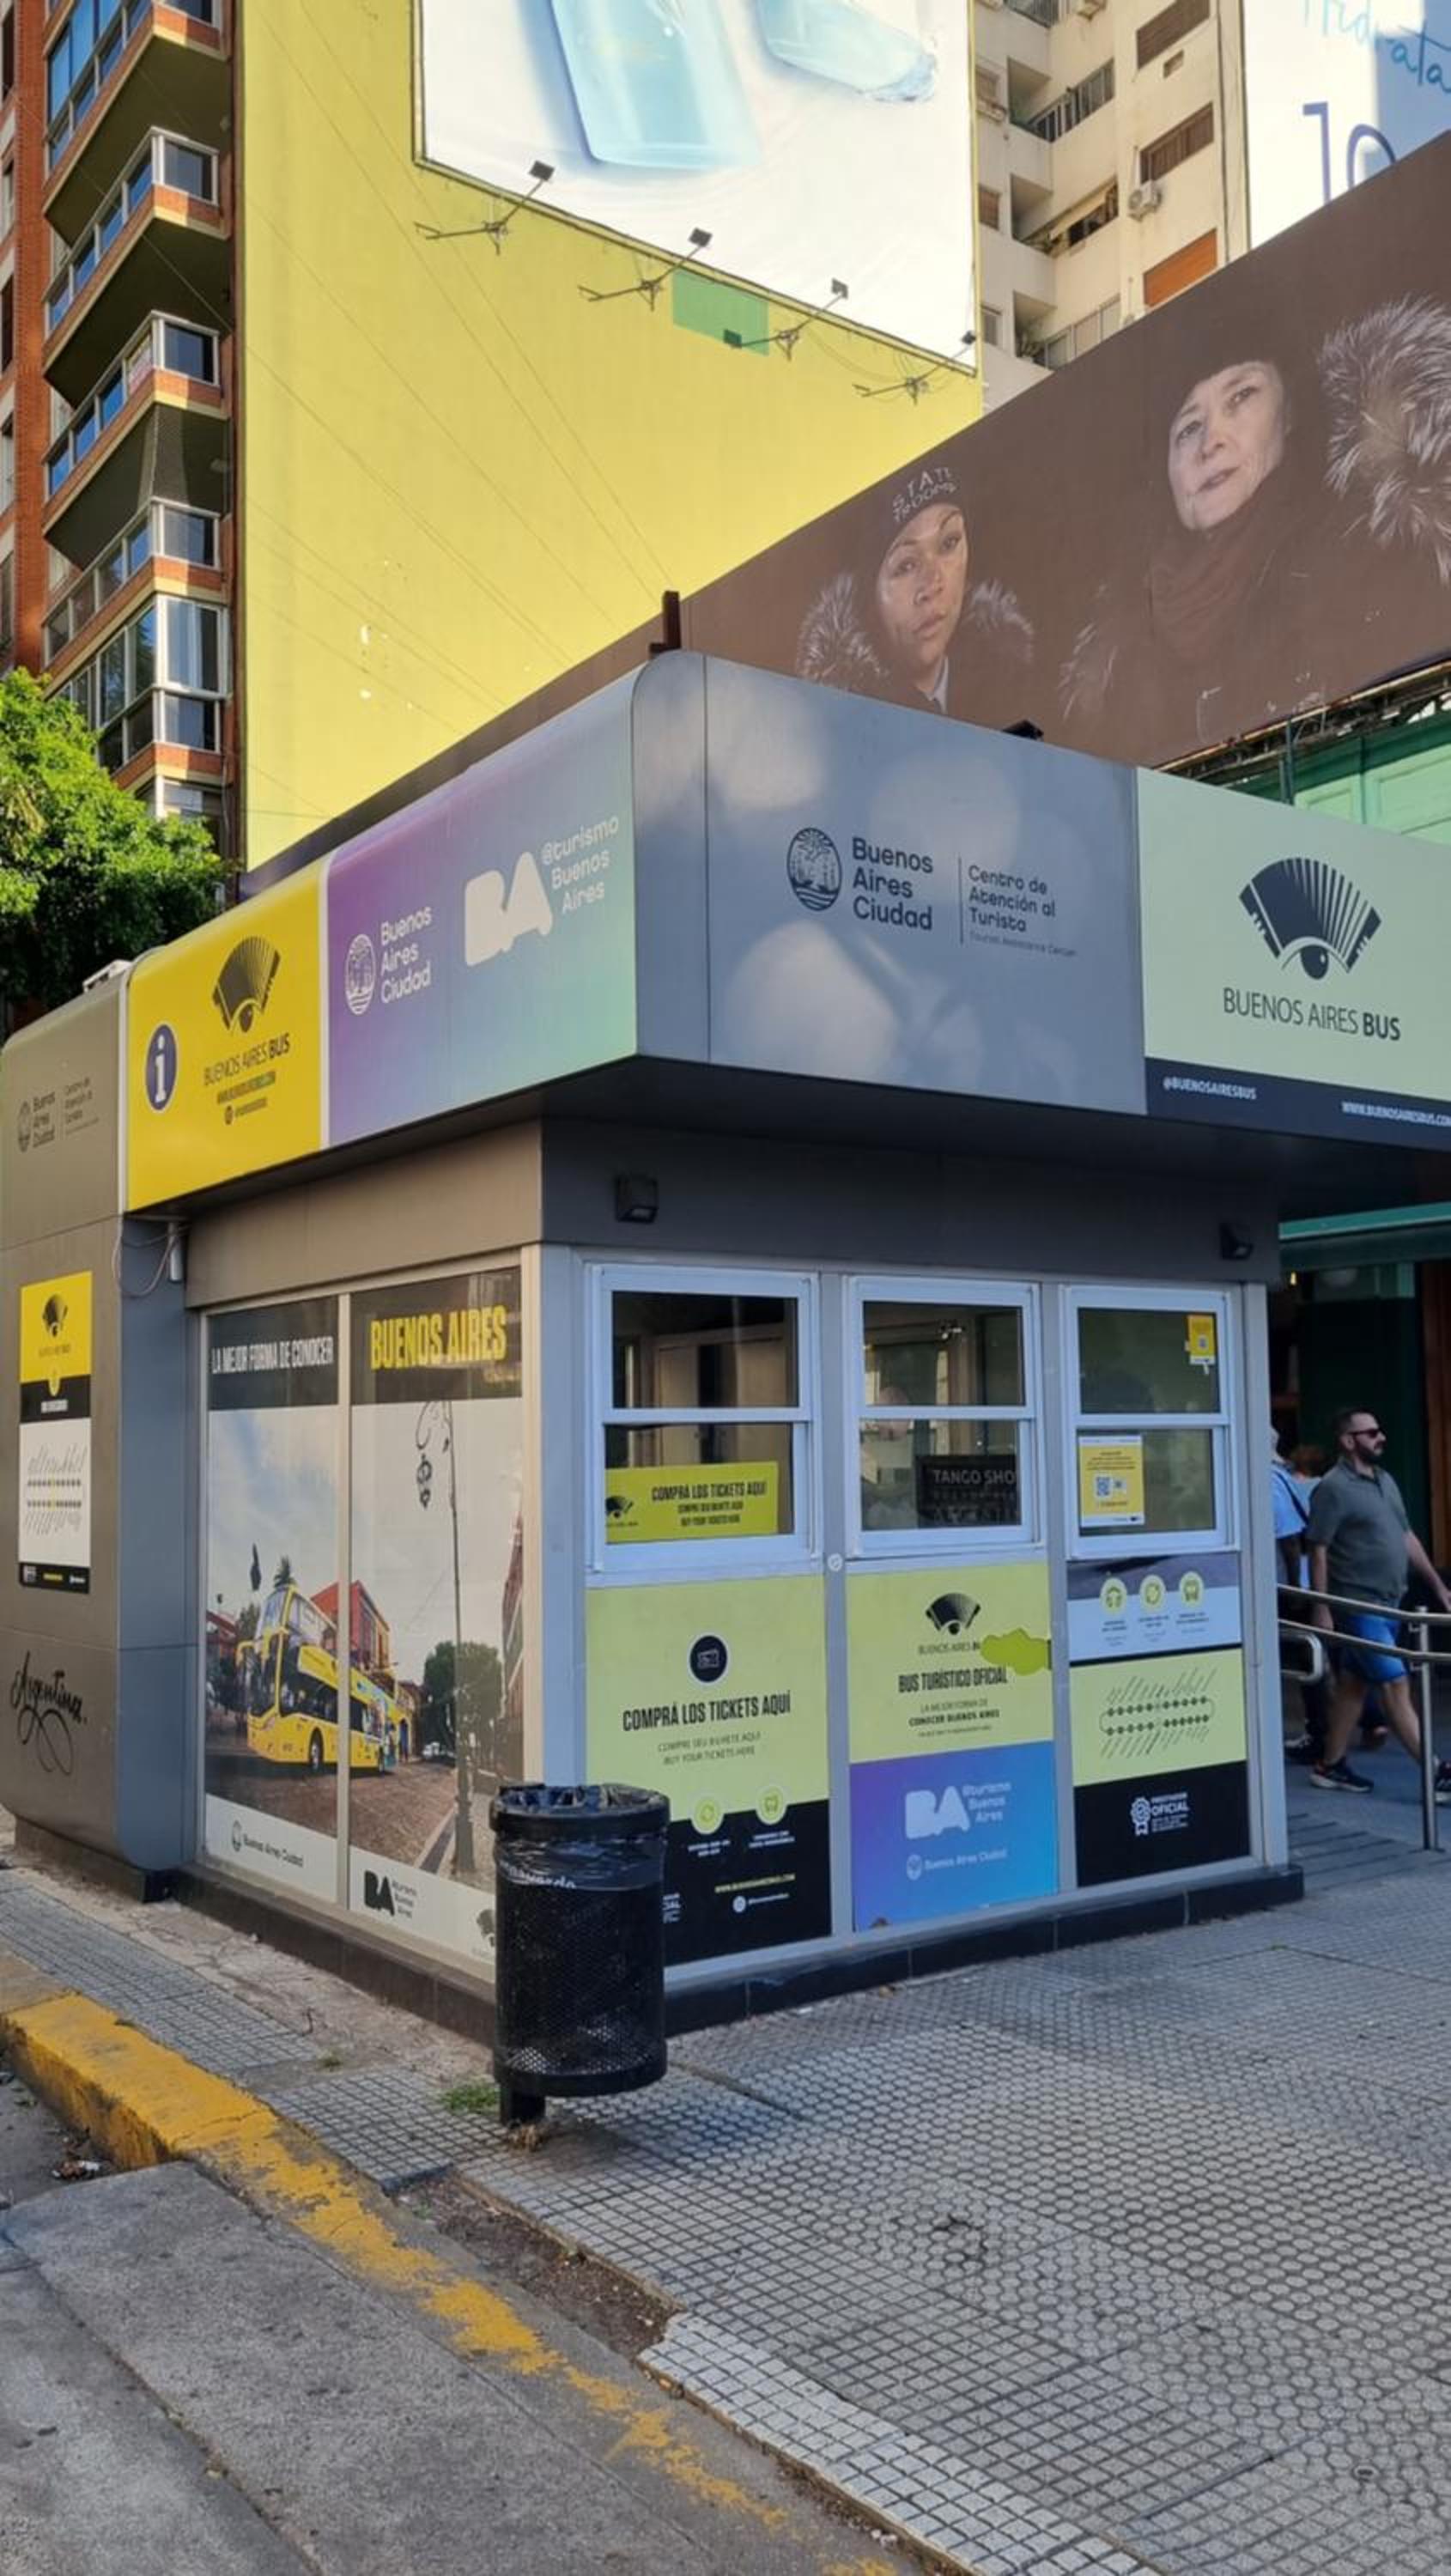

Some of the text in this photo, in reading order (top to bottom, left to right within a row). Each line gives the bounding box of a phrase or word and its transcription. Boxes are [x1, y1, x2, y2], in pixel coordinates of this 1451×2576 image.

[551, 851, 610, 890] Buenos
[852, 837, 933, 873] Buenos
[853, 867, 913, 899] Aires
[968, 865, 1047, 895] Centro de
[562, 882, 605, 914] Aires
[853, 896, 932, 931] Ciudad
[968, 886, 1055, 917] Atención al
[380, 907, 432, 945] Buenos
[968, 907, 1026, 933] Turista
[380, 943, 419, 976] Aires
[380, 963, 431, 1003] Ciudad
[1223, 987, 1400, 1041] BUENOS AIRES BUS
[270, 1033, 290, 1059] BUS
[1163, 1076, 1257, 1100] @BUENOSAIRESBUS
[370, 1305, 507, 1371] BUENOS AIRES
[212, 1336, 333, 1373] LA MEJOR FORMA DE CONOCER
[693, 1484, 708, 1499] LOS
[711, 1482, 745, 1498] TICKETS
[932, 1469, 1017, 1485] TANGO SHO
[898, 1674, 919, 1694] BUS
[973, 1667, 1007, 1686] OFICIAL
[682, 1703, 706, 1725] LOS
[709, 1696, 758, 1721] TICKETS
[1151, 1801, 1190, 1816] OFICIAL
